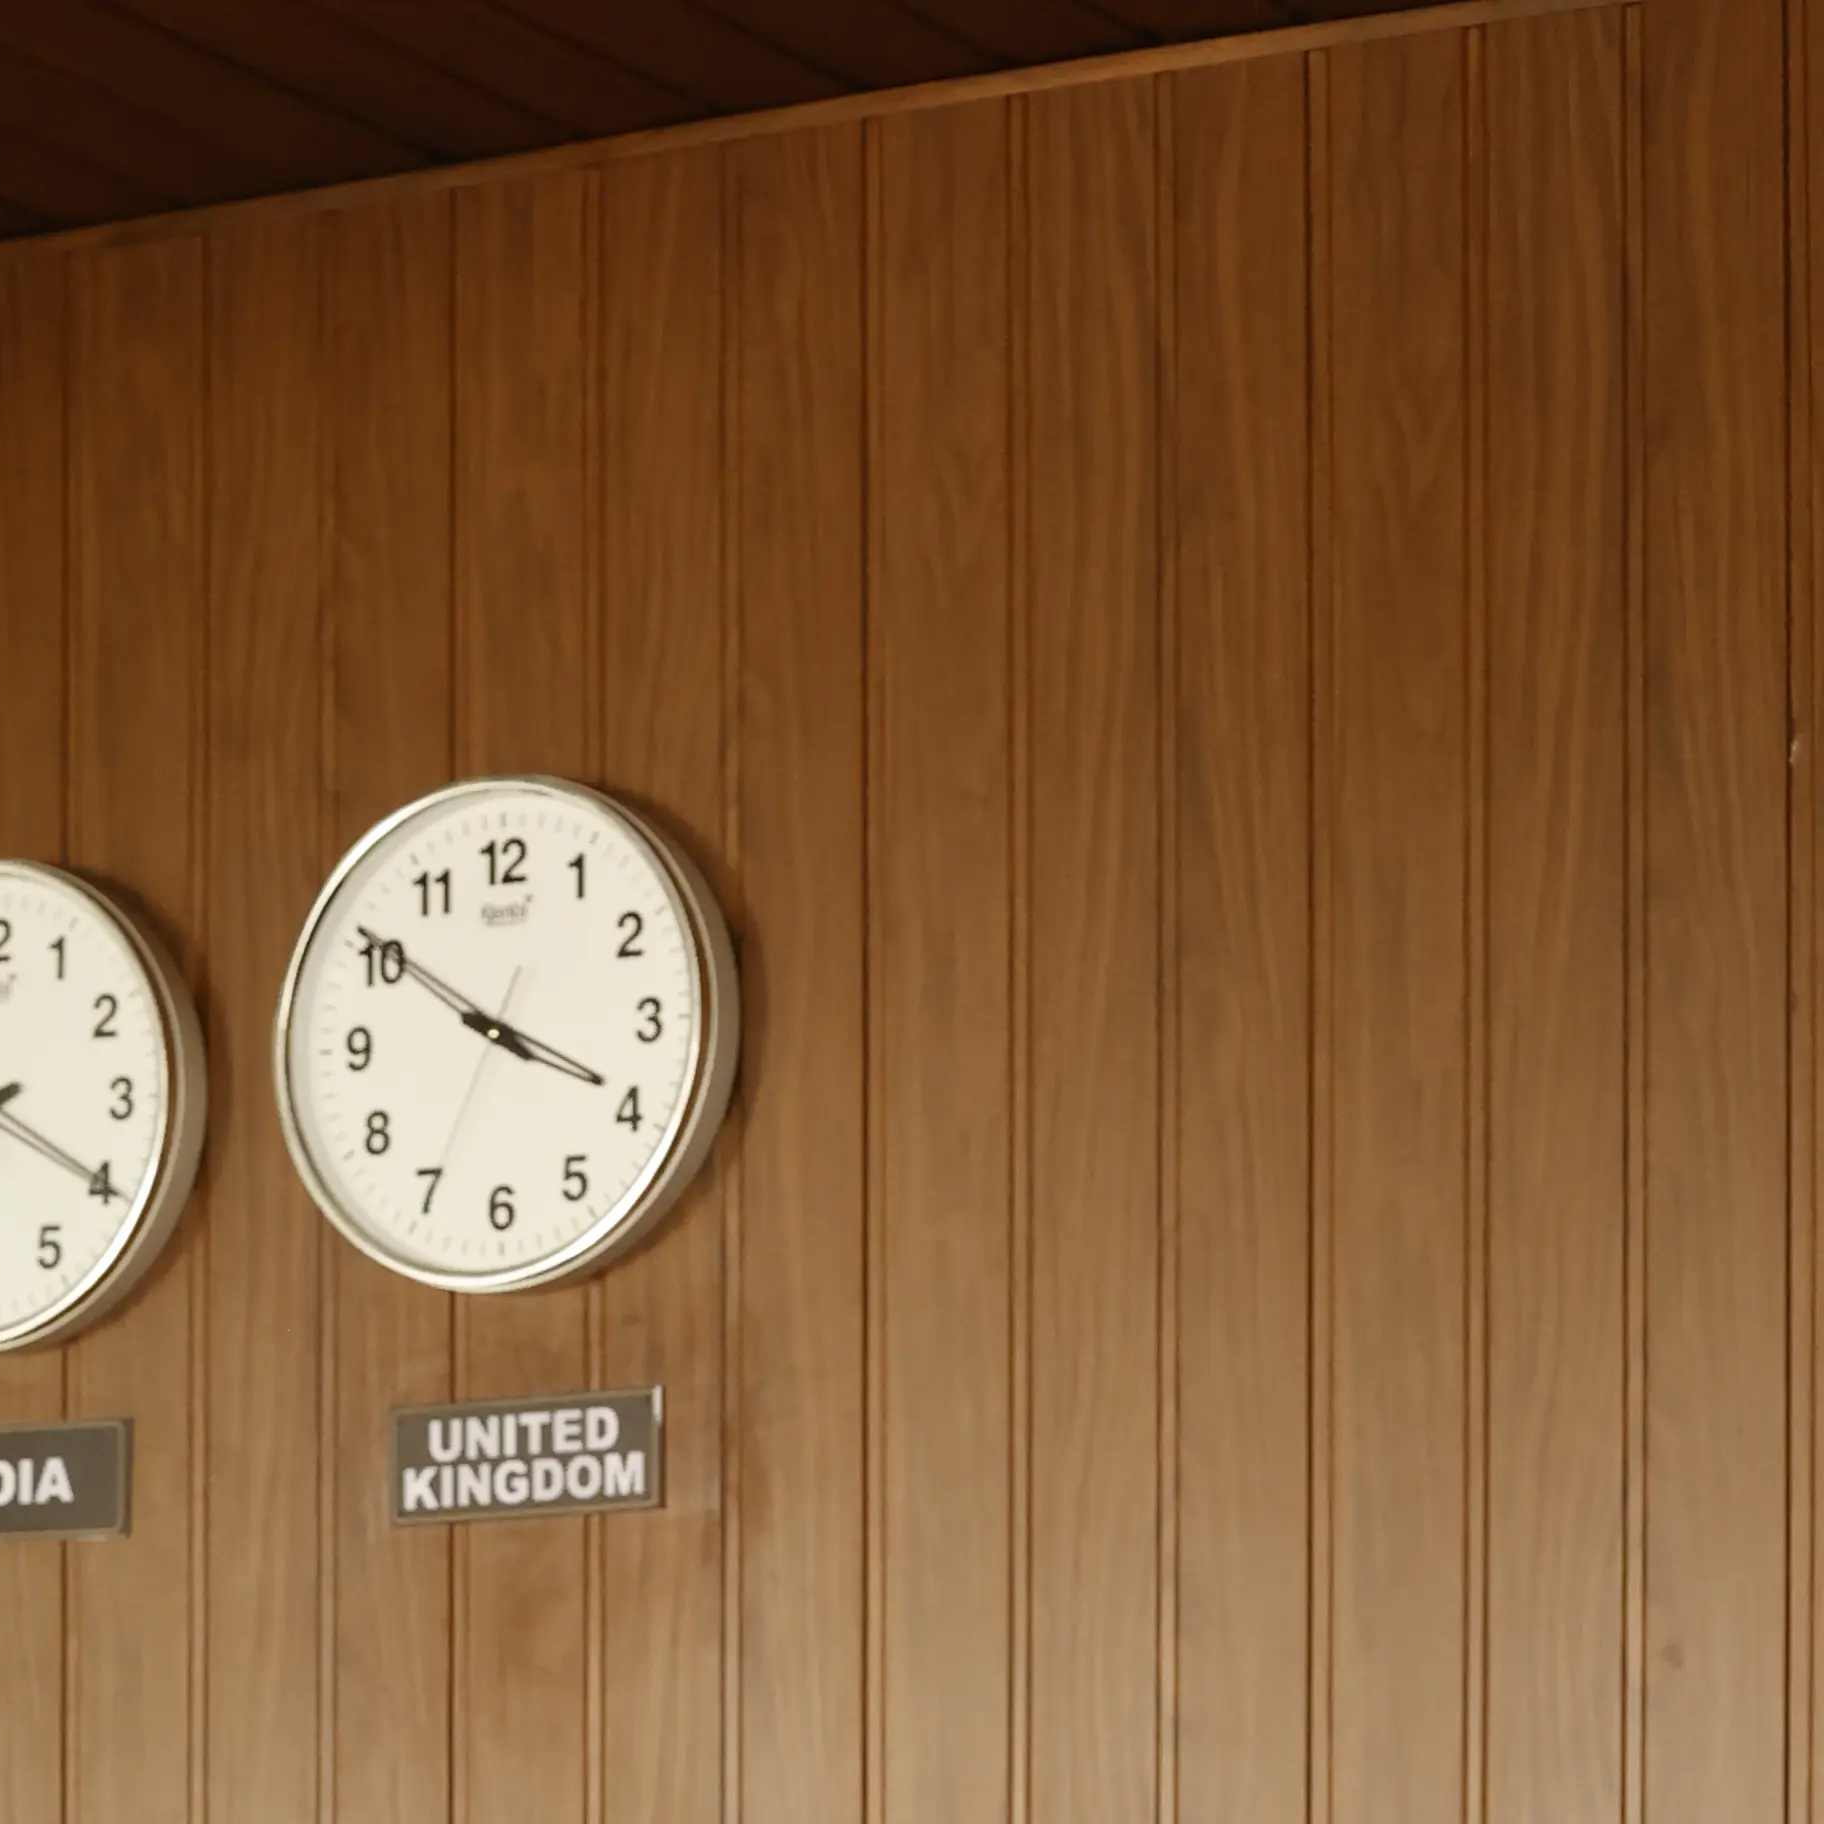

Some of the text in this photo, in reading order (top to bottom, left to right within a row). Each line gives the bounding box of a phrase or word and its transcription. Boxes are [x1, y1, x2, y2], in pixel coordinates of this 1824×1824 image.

[479, 837, 527, 886] 12
[568, 852, 585, 900] 1
[413, 869, 451, 917] 11
[49, 936, 65, 980] 1
[616, 911, 644, 959] 2
[358, 940, 405, 986] 10
[93, 993, 118, 1038] 2
[636, 996, 663, 1044] 3
[346, 1026, 373, 1072] 9
[109, 1076, 134, 1121] 3
[615, 1085, 643, 1132] 4
[364, 1110, 391, 1156] 8
[88, 1161, 116, 1204] 4
[416, 1167, 444, 1214] 7
[562, 1155, 588, 1202] 5
[489, 1185, 515, 1232] 6
[38, 1225, 62, 1269] 5
[428, 1406, 620, 1463] UNITED
[402, 1451, 646, 1511] KINGDOM
